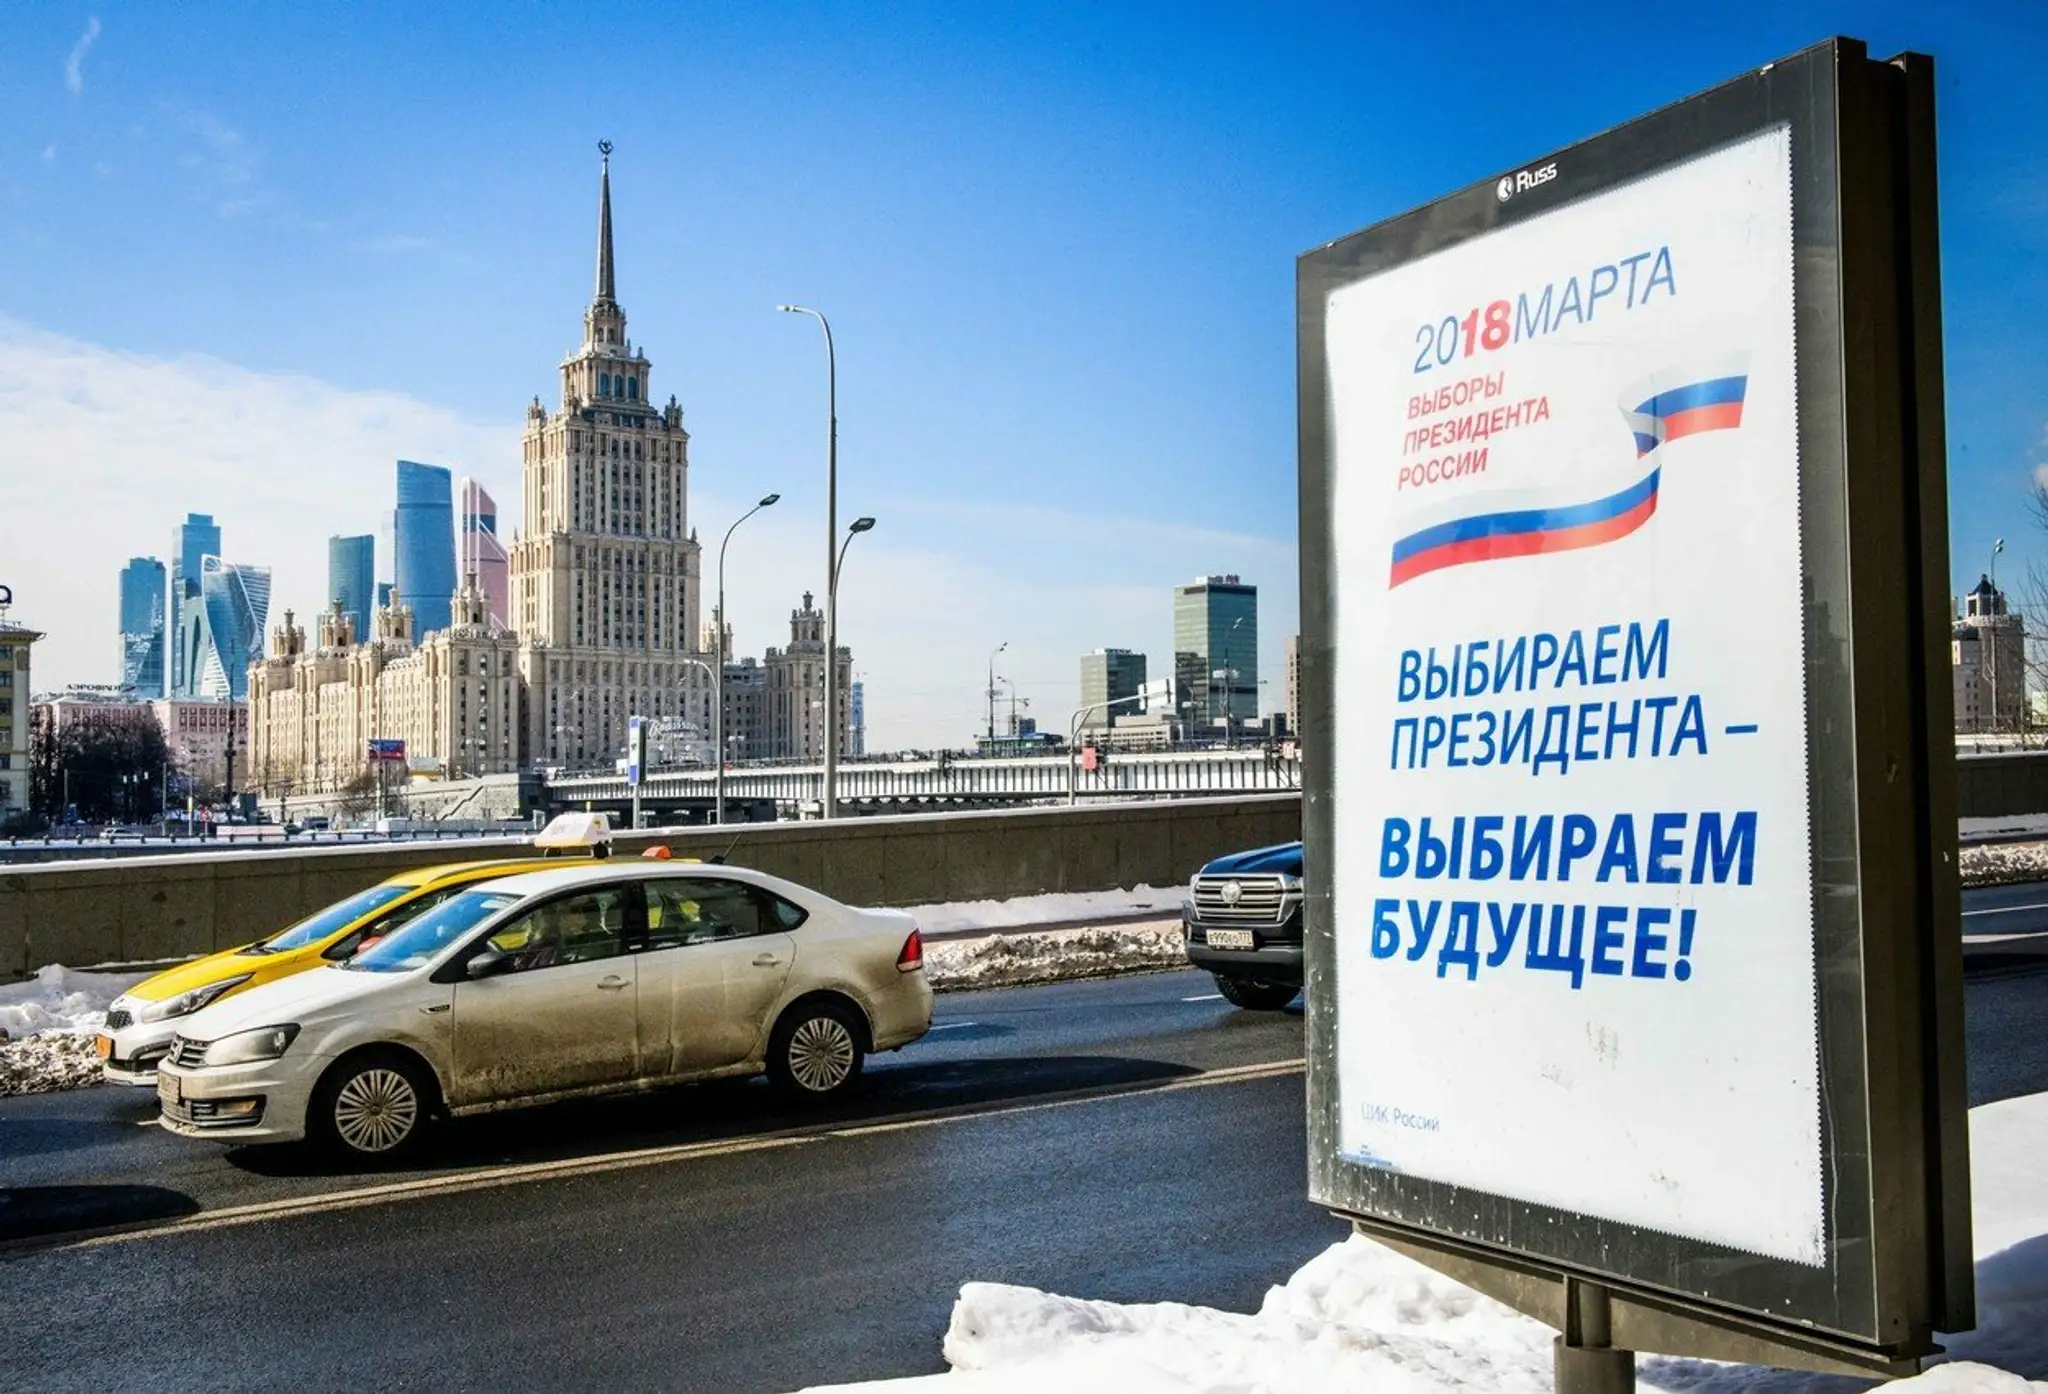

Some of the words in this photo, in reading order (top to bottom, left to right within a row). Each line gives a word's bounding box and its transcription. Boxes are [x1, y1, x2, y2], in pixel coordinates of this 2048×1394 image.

[1516, 163, 1558, 193] Russ
[1403, 396, 1550, 456] ПРЕЗИДЕНТА
[1407, 371, 1505, 420] ВЫБОРЫ
[1397, 448, 1489, 492] РОССИИ
[1397, 618, 1670, 703] ВЫБИРАЕМ
[1390, 694, 1709, 776] ПРЕЗИДЕНТА
[1379, 811, 1758, 886] ВЫБИРАЕМ
[1370, 898, 1697, 990] БУДУЩЕЕ!
